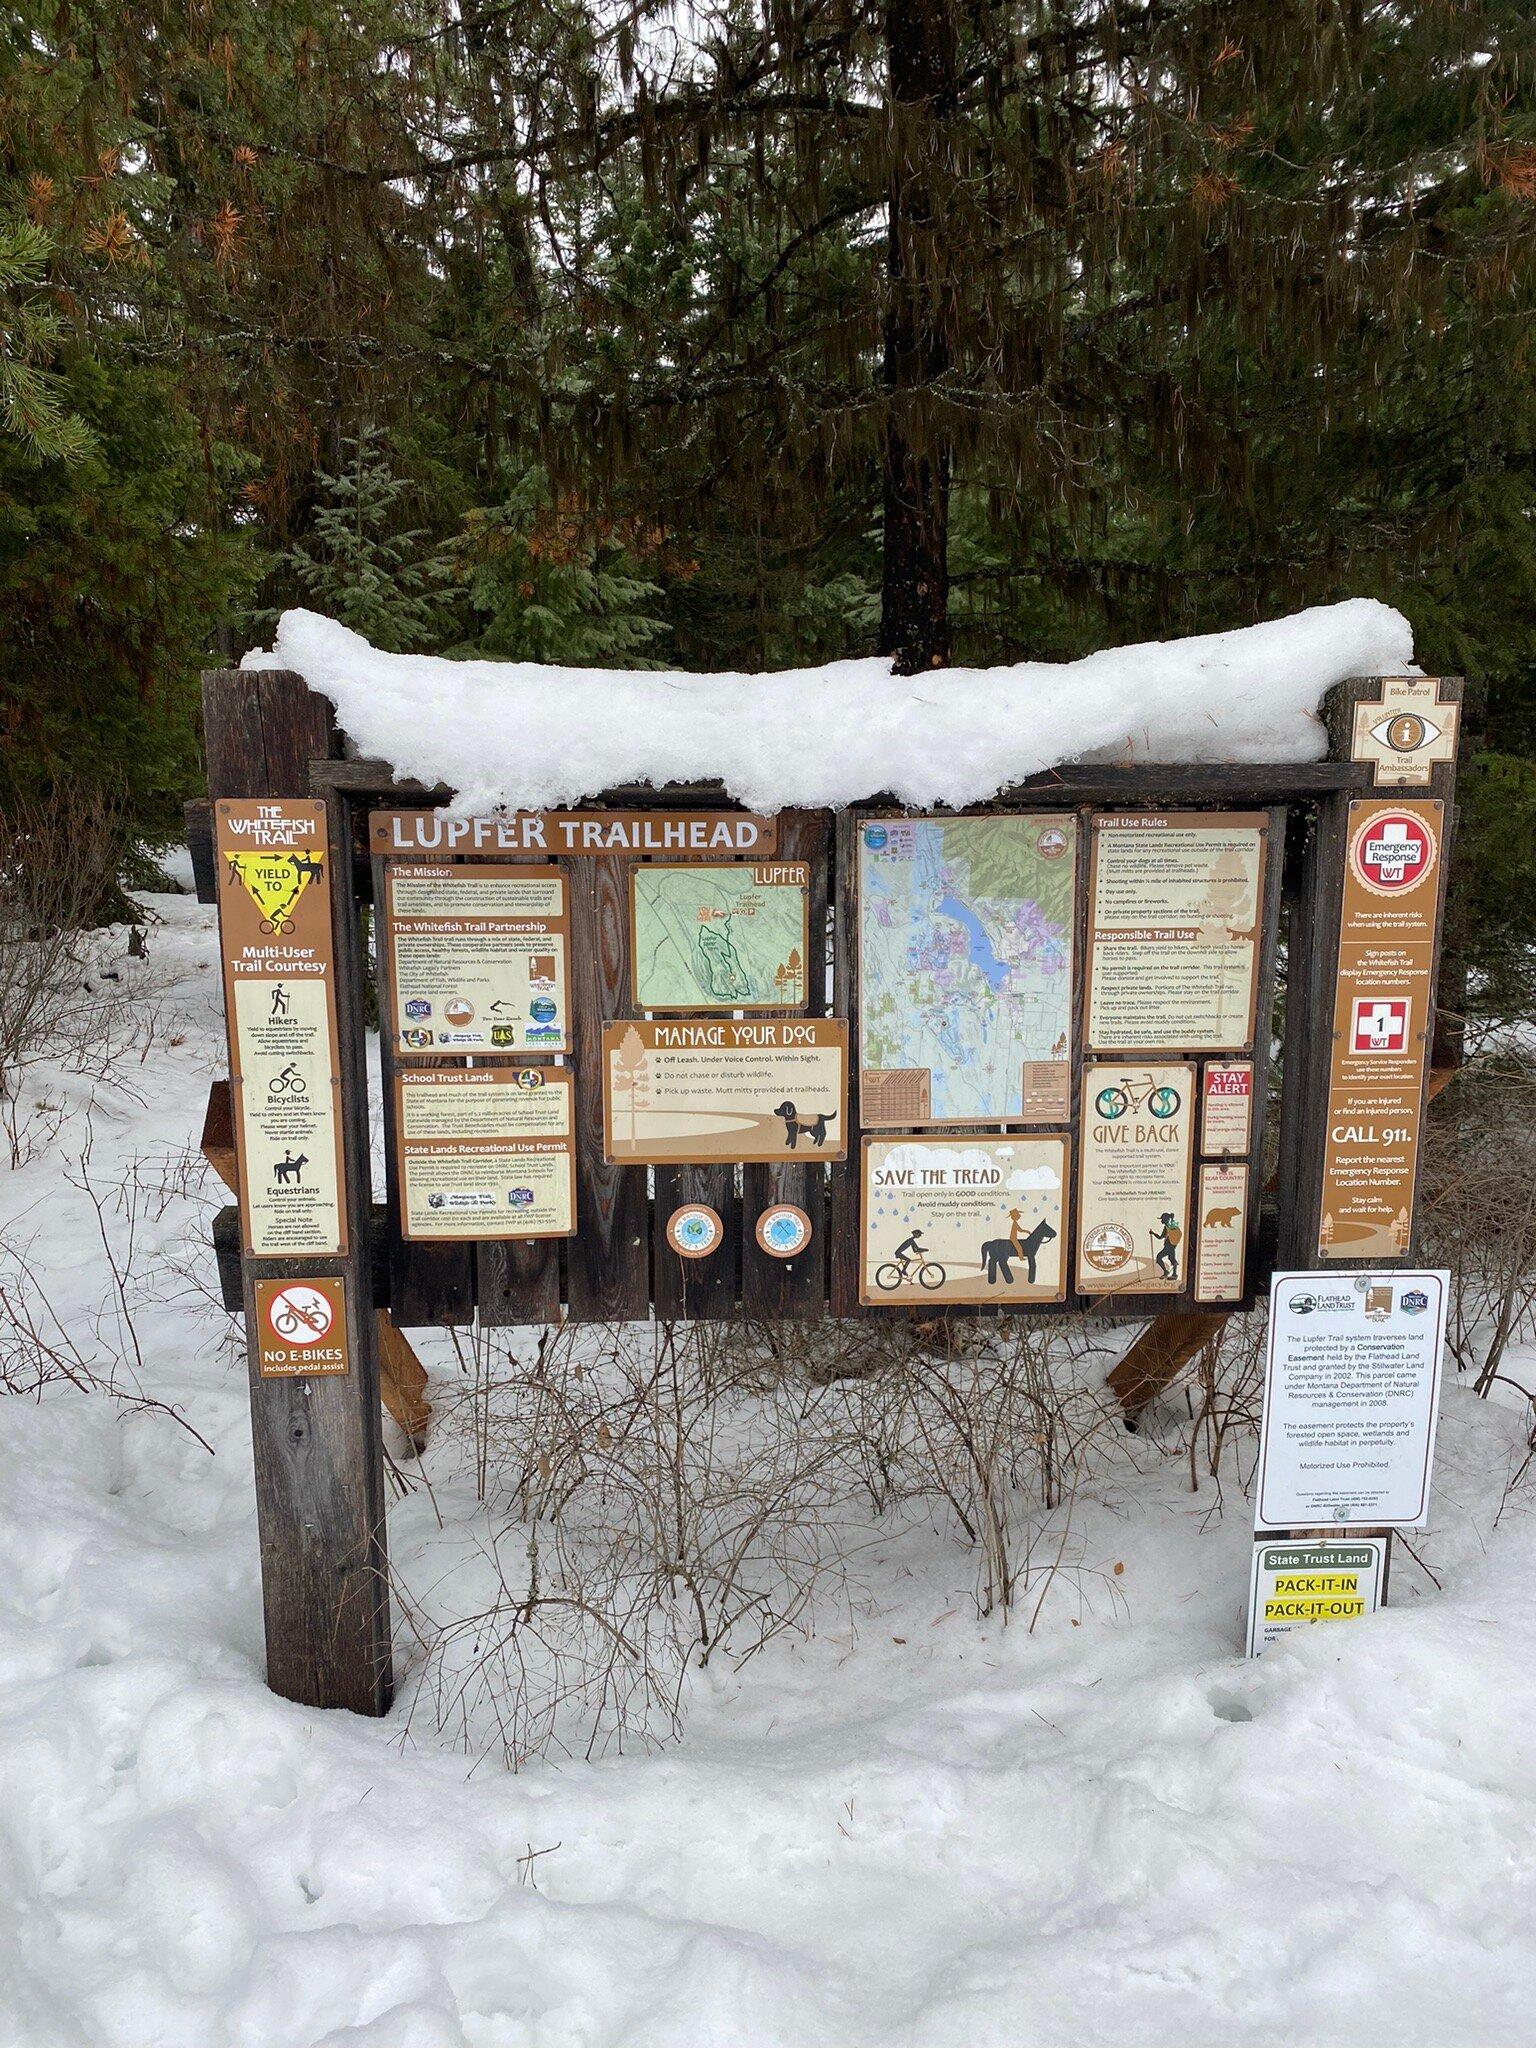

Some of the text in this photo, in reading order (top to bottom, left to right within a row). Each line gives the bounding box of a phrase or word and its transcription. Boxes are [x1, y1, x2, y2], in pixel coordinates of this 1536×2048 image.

[1407, 688, 1429, 696] Patrol
[257, 806, 282, 818] THE
[228, 820, 314, 834] WHITEFISH
[1142, 818, 1167, 826] Rules
[252, 831, 298, 844] TRAIL
[393, 818, 758, 848] LUPFER TRAILHEAD
[1369, 842, 1421, 853] Emergency
[1373, 853, 1416, 863] Response
[255, 869, 290, 879] YIELD
[393, 868, 452, 876] The Mission
[755, 868, 805, 883] LUPFER
[1383, 868, 1402, 879] WT
[265, 882, 282, 891] TO
[393, 922, 546, 932] The Whitefish Trail Partnership
[1095, 932, 1152, 941] Responsible
[1154, 931, 1175, 939] Trail
[243, 947, 314, 958] Multi-User
[232, 961, 326, 974] Trail Courtesy
[407, 1005, 430, 1013] DNRC
[1377, 1018, 1384, 1032] 1
[655, 1026, 815, 1045] MANAGE YOUR DOG
[1372, 1038, 1387, 1046] WT
[801, 1055, 820, 1063] Sight.
[402, 1073, 493, 1082] School Trust Lands
[1214, 1074, 1244, 1083] STAY
[754, 1086, 785, 1095] provided
[1209, 1084, 1248, 1094] ALERT
[267, 1096, 309, 1104] Bicyclists
[1093, 1125, 1179, 1143] GIVE BACK
[1332, 1126, 1411, 1146] CALL 911.
[405, 1146, 428, 1154] State
[431, 1145, 457, 1153] Lands
[460, 1144, 515, 1153] Recreational
[537, 1142, 567, 1151] Permit
[1336, 1157, 1362, 1165] Report
[875, 1169, 1000, 1185] SAVE THE TREAD
[1330, 1168, 1409, 1176] Emergency Response
[267, 1187, 319, 1196] Equestrians
[510, 1193, 533, 1201] DNRC
[1403, 1297, 1427, 1306] DNRC
[1304, 1344, 1337, 1352] protected
[265, 1349, 342, 1361] NO E-BIKES
[299, 1364, 320, 1372] pedal
[1336, 1422, 1364, 1430] protects
[1269, 1554, 1368, 1565] State Trust Land
[1276, 1579, 1357, 1592] PACK-IT-IN
[1265, 1603, 1363, 1616] PACK-IT-OUT
